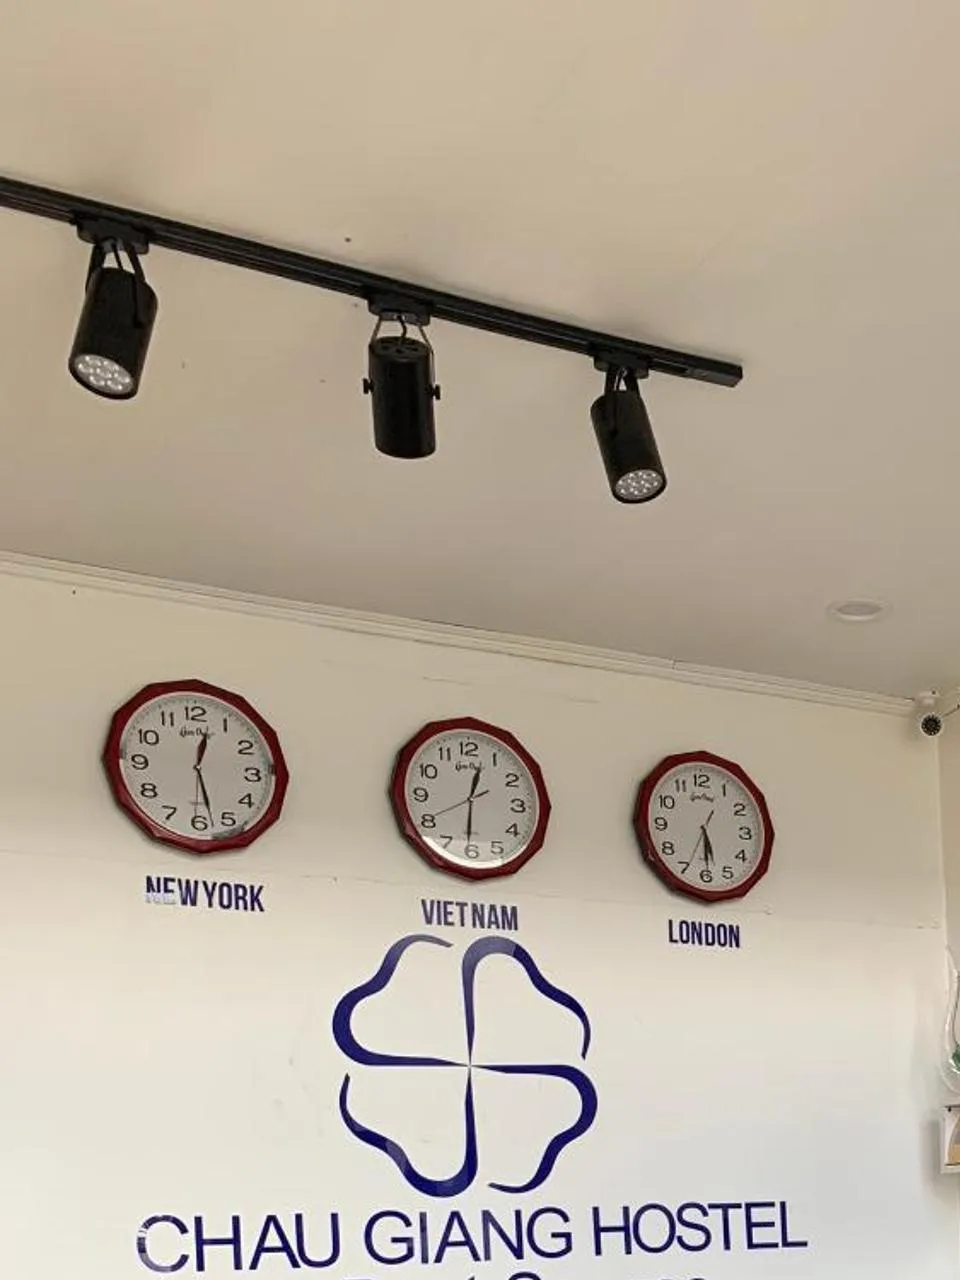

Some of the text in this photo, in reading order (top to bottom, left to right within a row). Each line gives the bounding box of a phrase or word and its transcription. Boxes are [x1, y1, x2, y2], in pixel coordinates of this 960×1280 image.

[161, 711, 175, 727] 11
[184, 705, 208, 723] 12
[138, 728, 160, 746] 10
[237, 739, 255, 756] 2
[438, 746, 451, 761] 11
[459, 741, 479, 757] 12
[131, 753, 149, 770] 9
[244, 766, 262, 783] 3
[419, 763, 438, 779] 10
[505, 772, 520, 788] 2
[674, 778, 687, 793] 11
[693, 773, 711, 789] 12
[140, 782, 158, 799] 8
[413, 786, 429, 802] 9
[238, 792, 255, 809] 4
[510, 797, 527, 814] 3
[659, 794, 676, 810] 10
[161, 804, 178, 821] 7
[733, 802, 747, 817] 2
[190, 814, 209, 832] 6
[220, 811, 237, 827] 5
[420, 813, 437, 829] 8
[654, 816, 669, 831] 9
[504, 822, 521, 838] 4
[738, 825, 753, 841] 3
[439, 834, 454, 849] 7
[490, 840, 505, 855] 5
[661, 840, 676, 856] 8
[463, 843, 480, 859] 6
[734, 848, 748, 863] 4
[677, 860, 691, 875] 7
[721, 865, 735, 880] 5
[699, 869, 714, 884] 6
[145, 874, 265, 913] NEW YORK
[420, 898, 519, 932] VIETNAM
[667, 918, 741, 949] LONDON
[136, 1200, 809, 1274] CHAU GIANG HOSTEL
